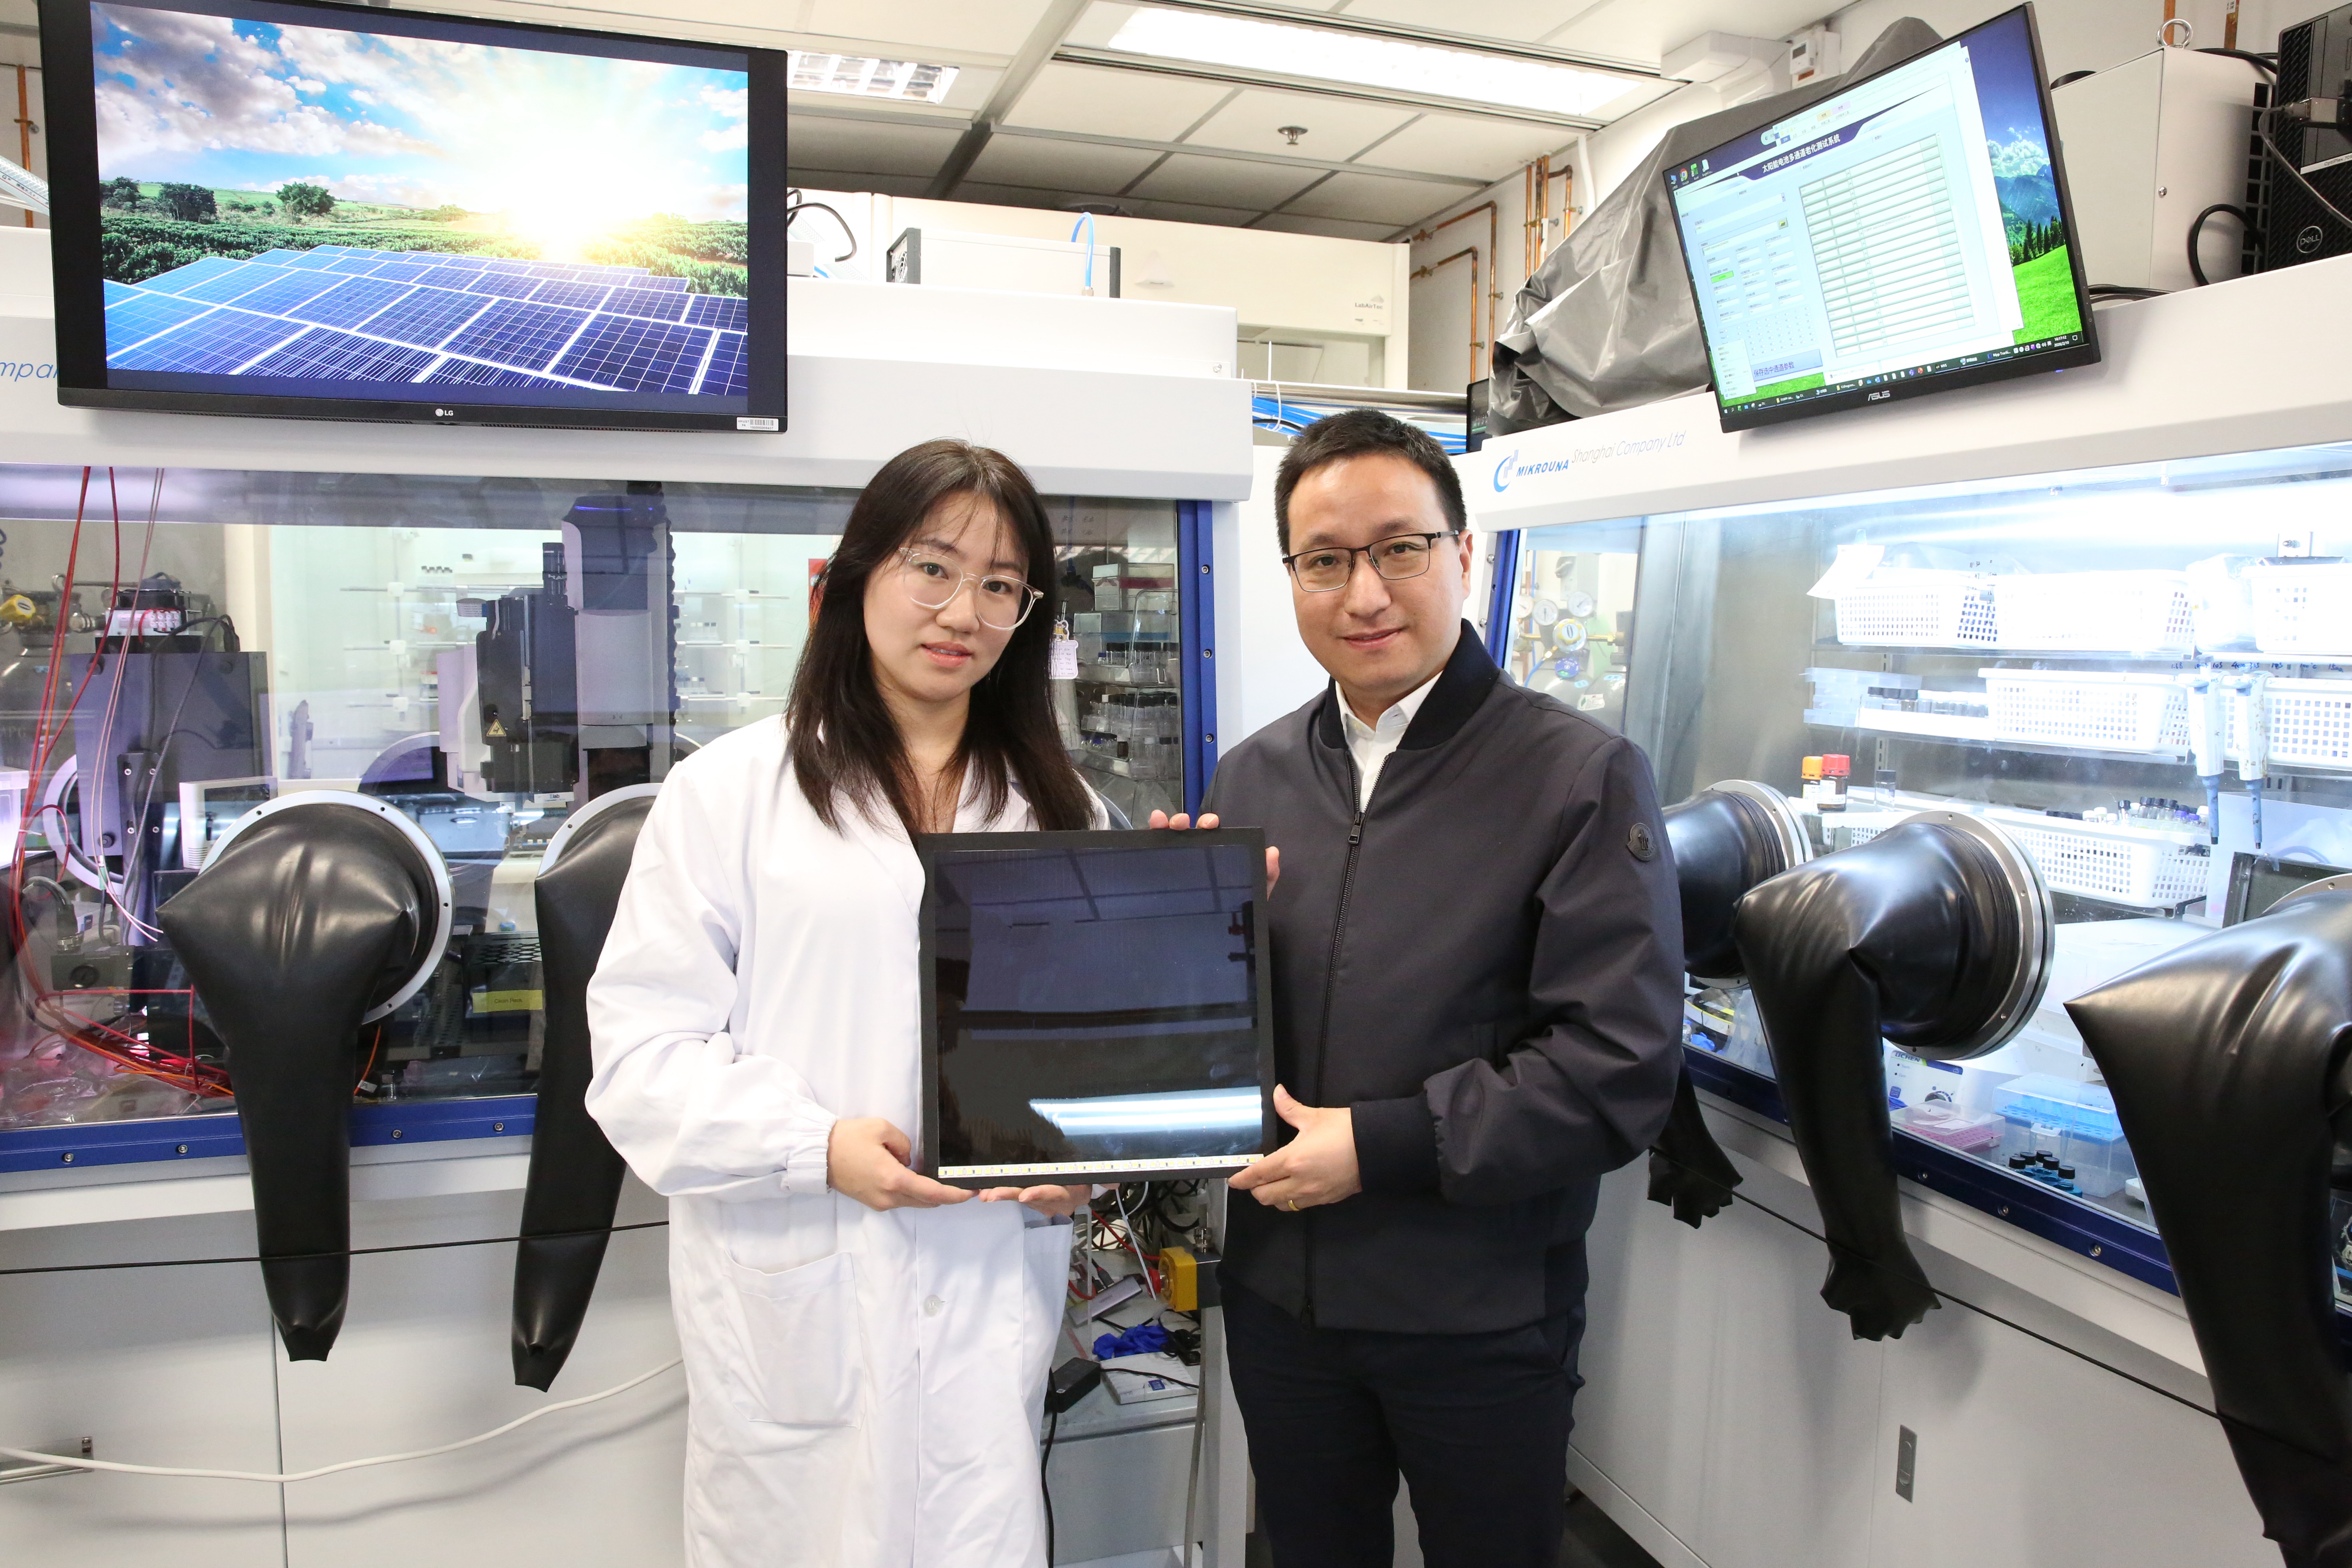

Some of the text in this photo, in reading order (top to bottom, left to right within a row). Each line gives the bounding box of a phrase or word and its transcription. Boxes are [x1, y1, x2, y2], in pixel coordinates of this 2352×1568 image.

[1762, 134, 1841, 173] 太阳能电池多通道老化测试系统
[2300, 235, 2320, 245] DELL
[0, 362, 57, 382] mpa
[1754, 361, 1794, 377] 保存选中通道参数
[1867, 390, 1890, 401] ASUS
[1517, 432, 1687, 476] MIKROUNA Shanghai Company Ltd
